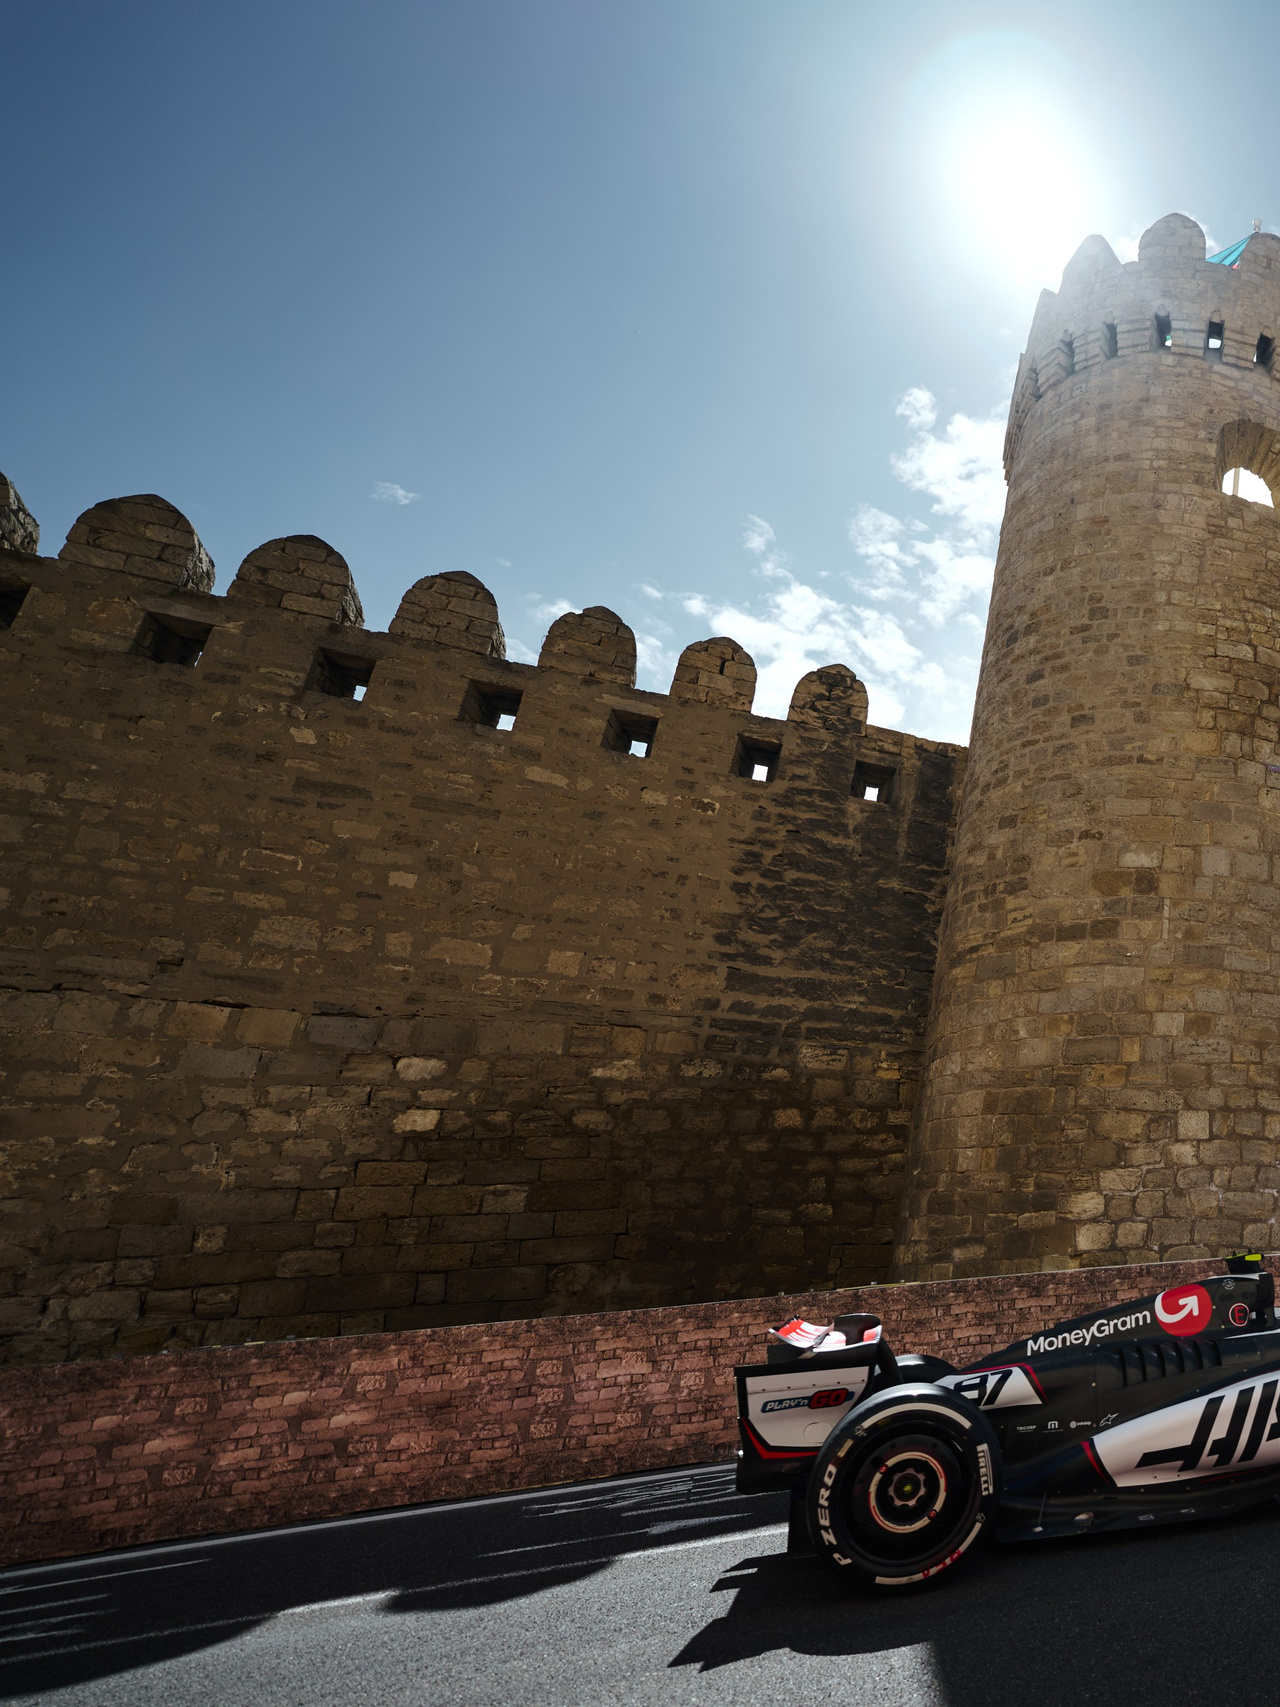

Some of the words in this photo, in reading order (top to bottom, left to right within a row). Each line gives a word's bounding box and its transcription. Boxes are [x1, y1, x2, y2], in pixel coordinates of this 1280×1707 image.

[1026, 1311, 1151, 1357] MoneyGram
[811, 1389, 849, 1408] GO
[976, 1443, 994, 1496] PIRELLI
[818, 1463, 838, 1546] ZERO
